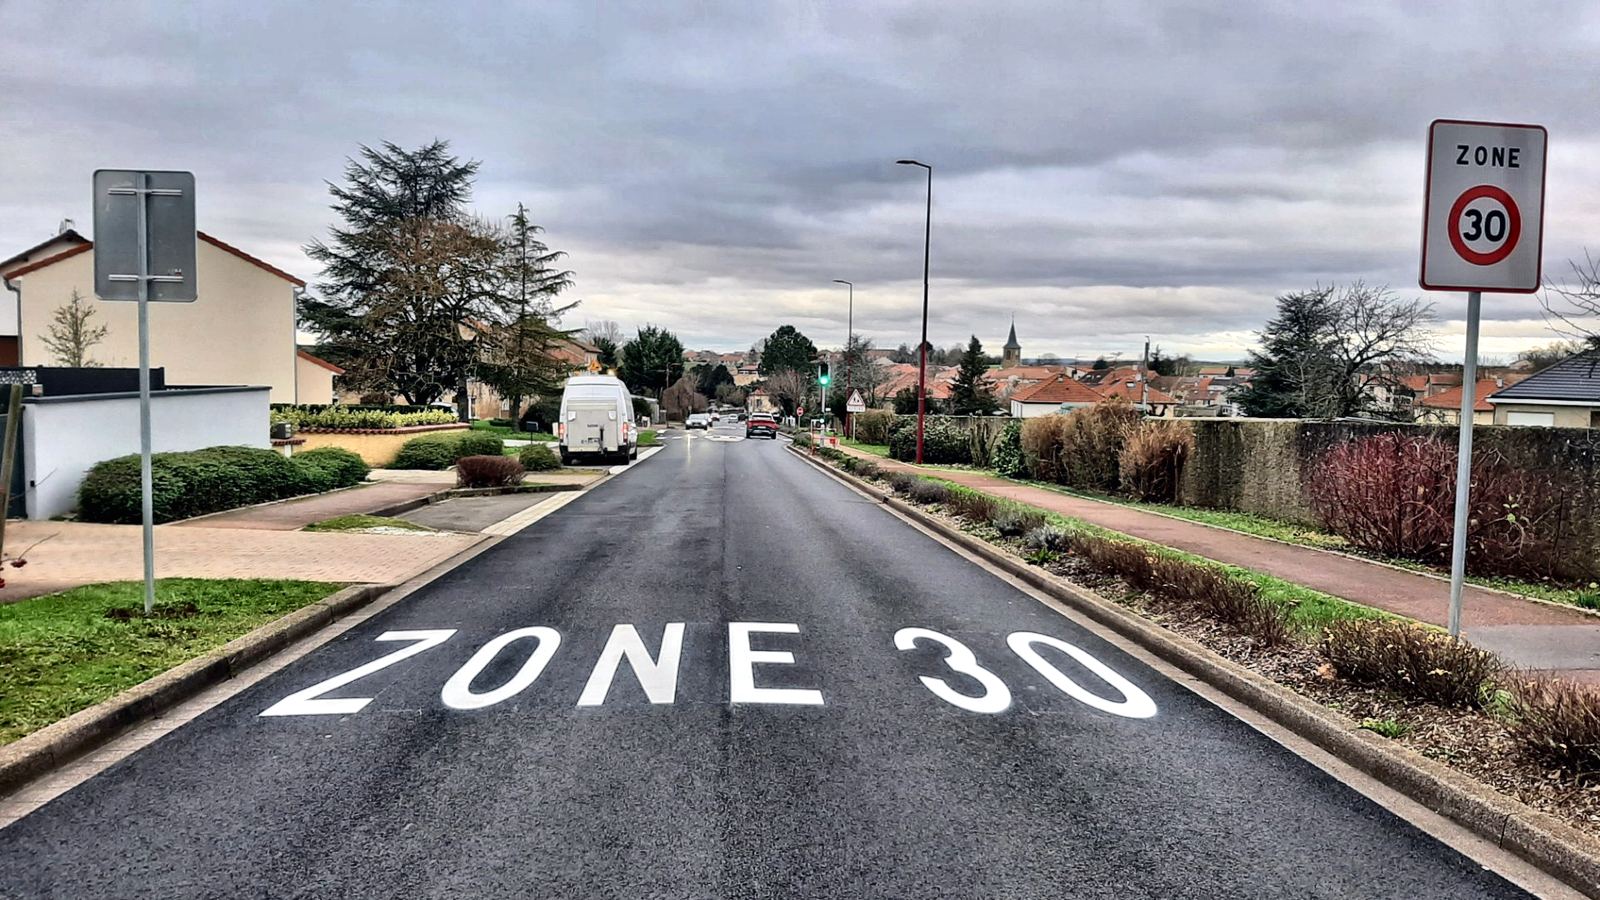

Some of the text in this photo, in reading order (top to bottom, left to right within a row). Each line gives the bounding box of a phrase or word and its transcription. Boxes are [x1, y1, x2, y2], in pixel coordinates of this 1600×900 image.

[1456, 145, 1520, 168] ZONE
[1463, 209, 1506, 242] 30
[259, 622, 1159, 719] ZONE 30
